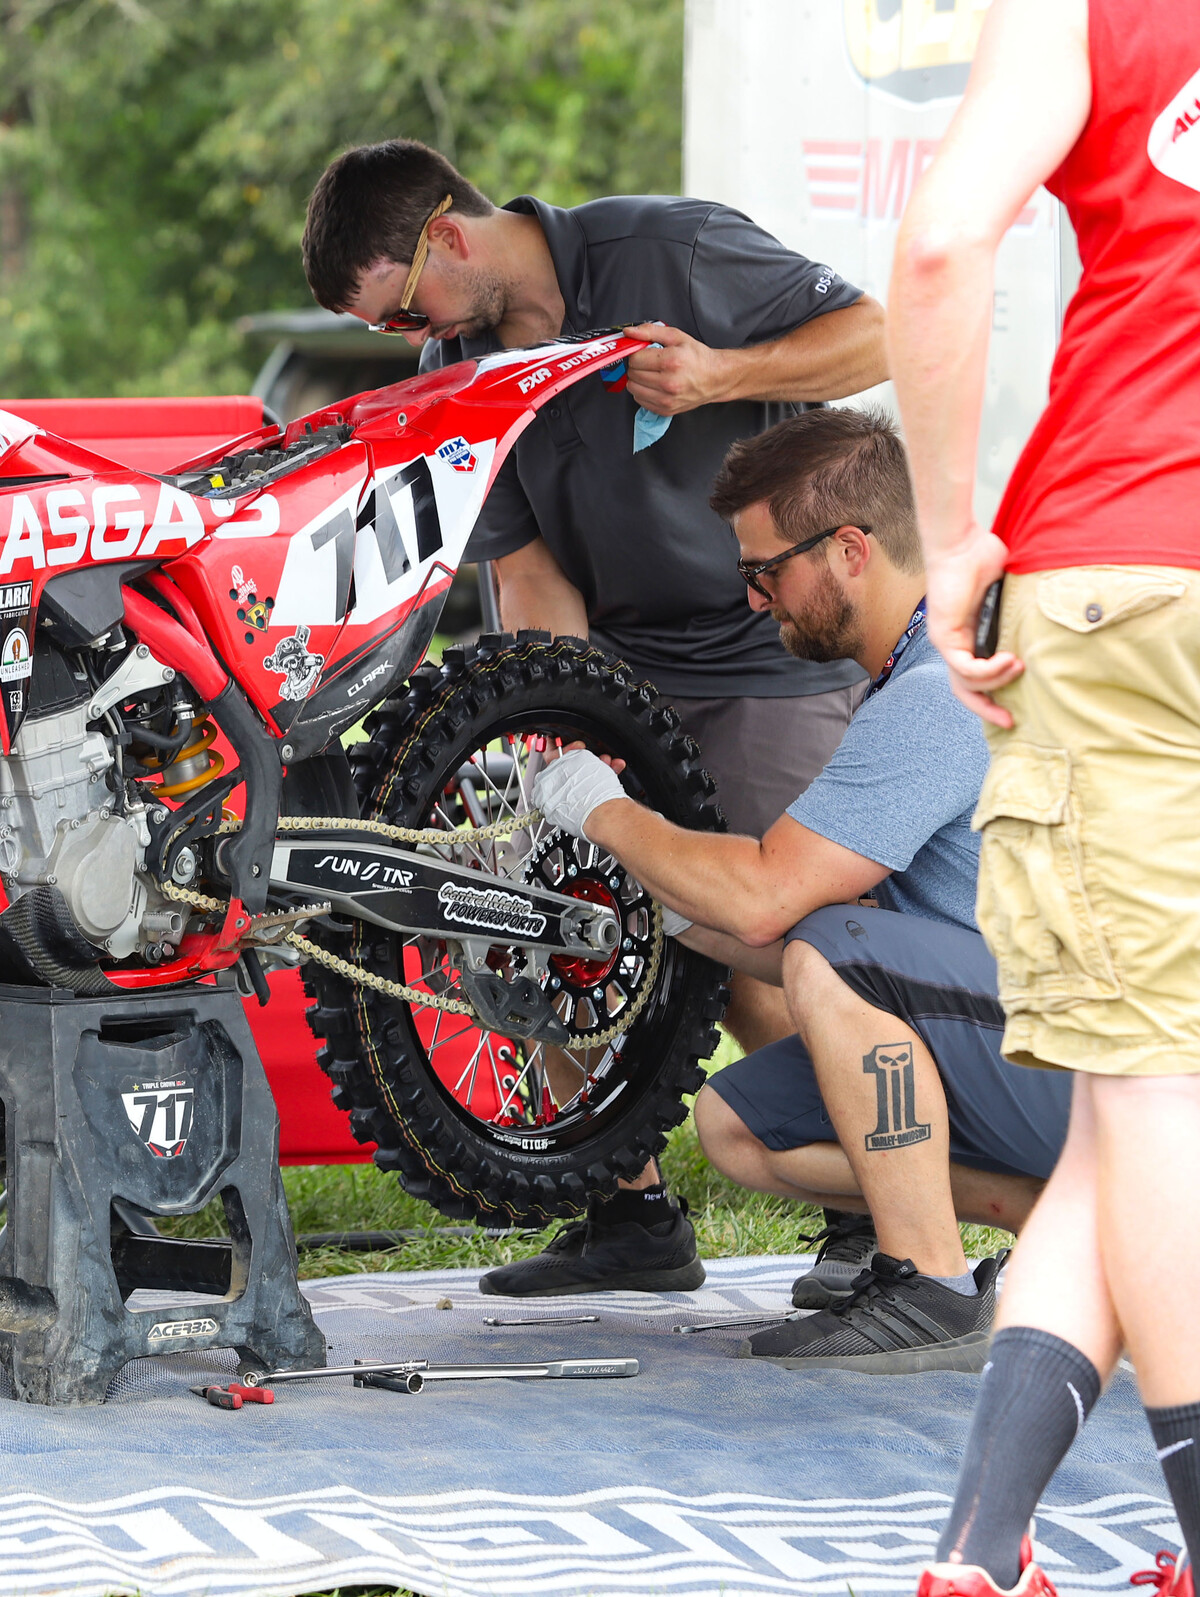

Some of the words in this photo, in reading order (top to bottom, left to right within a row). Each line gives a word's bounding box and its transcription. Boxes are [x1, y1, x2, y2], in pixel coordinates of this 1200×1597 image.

[517, 367, 552, 394] FXR
[557, 341, 618, 372] DUNLOP
[310, 455, 443, 623] 717
[4, 609, 29, 620] FABRICATION
[0, 661, 30, 676] UNLEASHED
[347, 659, 394, 697] CLARK
[440, 885, 491, 907] Central
[489, 893, 532, 915] Maine
[447, 901, 544, 934] POWERSPORTS
[142, 1081, 160, 1090] TRIPLE
[160, 1080, 176, 1089] CROWN
[133, 1092, 193, 1143] 717
[871, 1127, 927, 1148] HARLEY-DAVIDSON
[644, 1193, 661, 1201] new
[148, 1320, 216, 1339] ACERBIS
